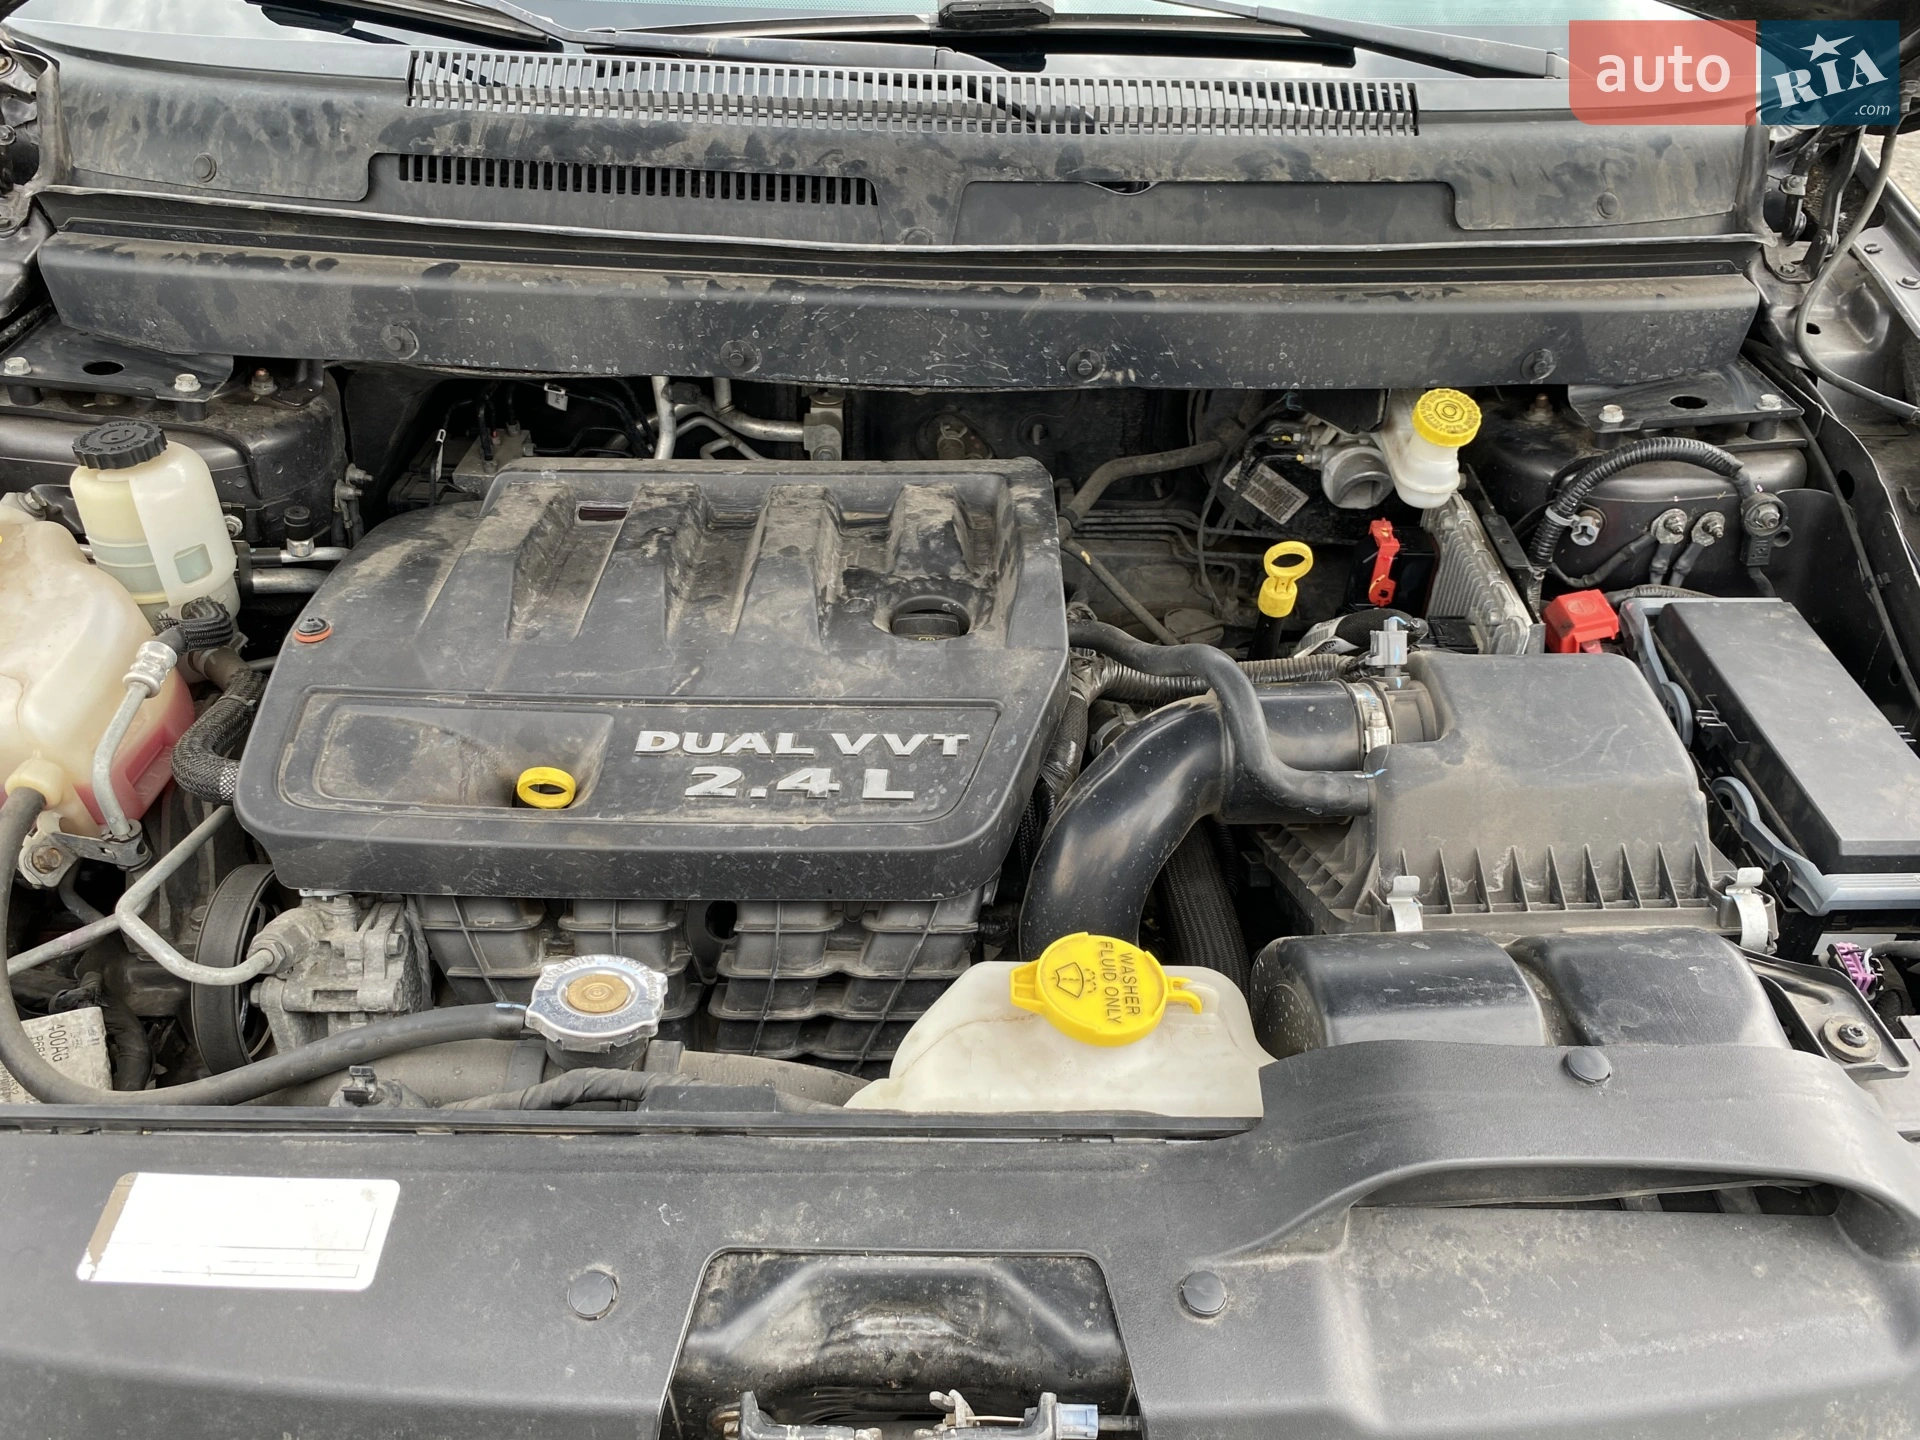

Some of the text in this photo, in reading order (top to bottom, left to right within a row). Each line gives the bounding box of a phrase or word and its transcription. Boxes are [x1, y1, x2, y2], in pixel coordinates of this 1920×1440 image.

[634, 730, 971, 757] DUAL VVT
[684, 766, 915, 800] 2.4 L
[1099, 941, 1122, 1024] FLUID ONLY
[1119, 952, 1141, 1015] WASHER
